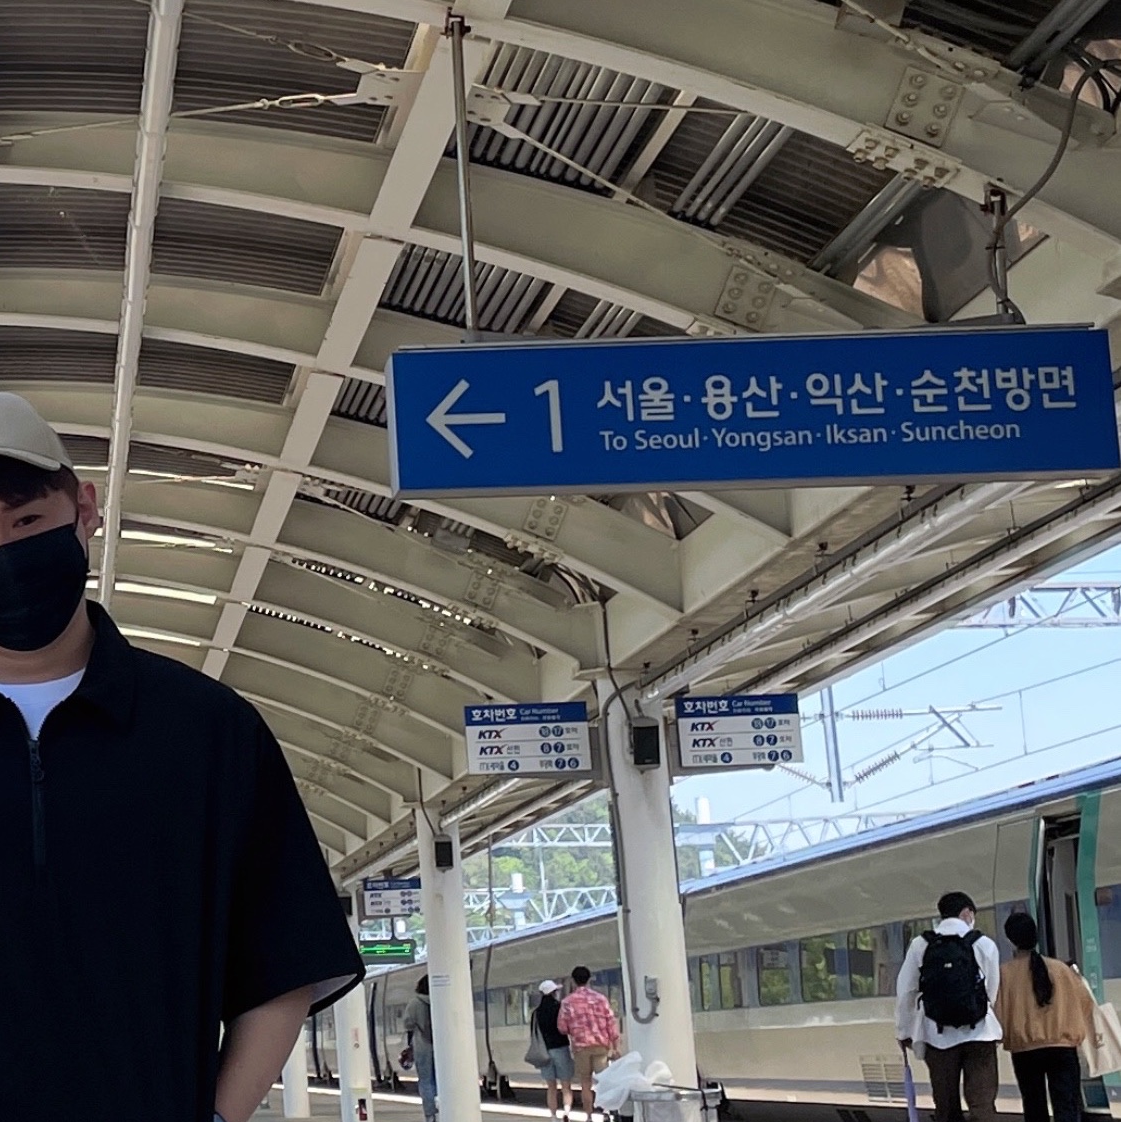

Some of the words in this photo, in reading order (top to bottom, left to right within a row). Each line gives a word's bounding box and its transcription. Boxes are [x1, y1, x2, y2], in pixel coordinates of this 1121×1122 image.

[534, 379, 564, 453] 1
[601, 431, 627, 451] To
[683, 700, 729, 714] 호차번호
[471, 708, 518, 722] 호차번호
[478, 727, 507, 739] KTX
[690, 721, 717, 732] KTX
[692, 737, 719, 748] KTX
[479, 744, 506, 755] KTX
